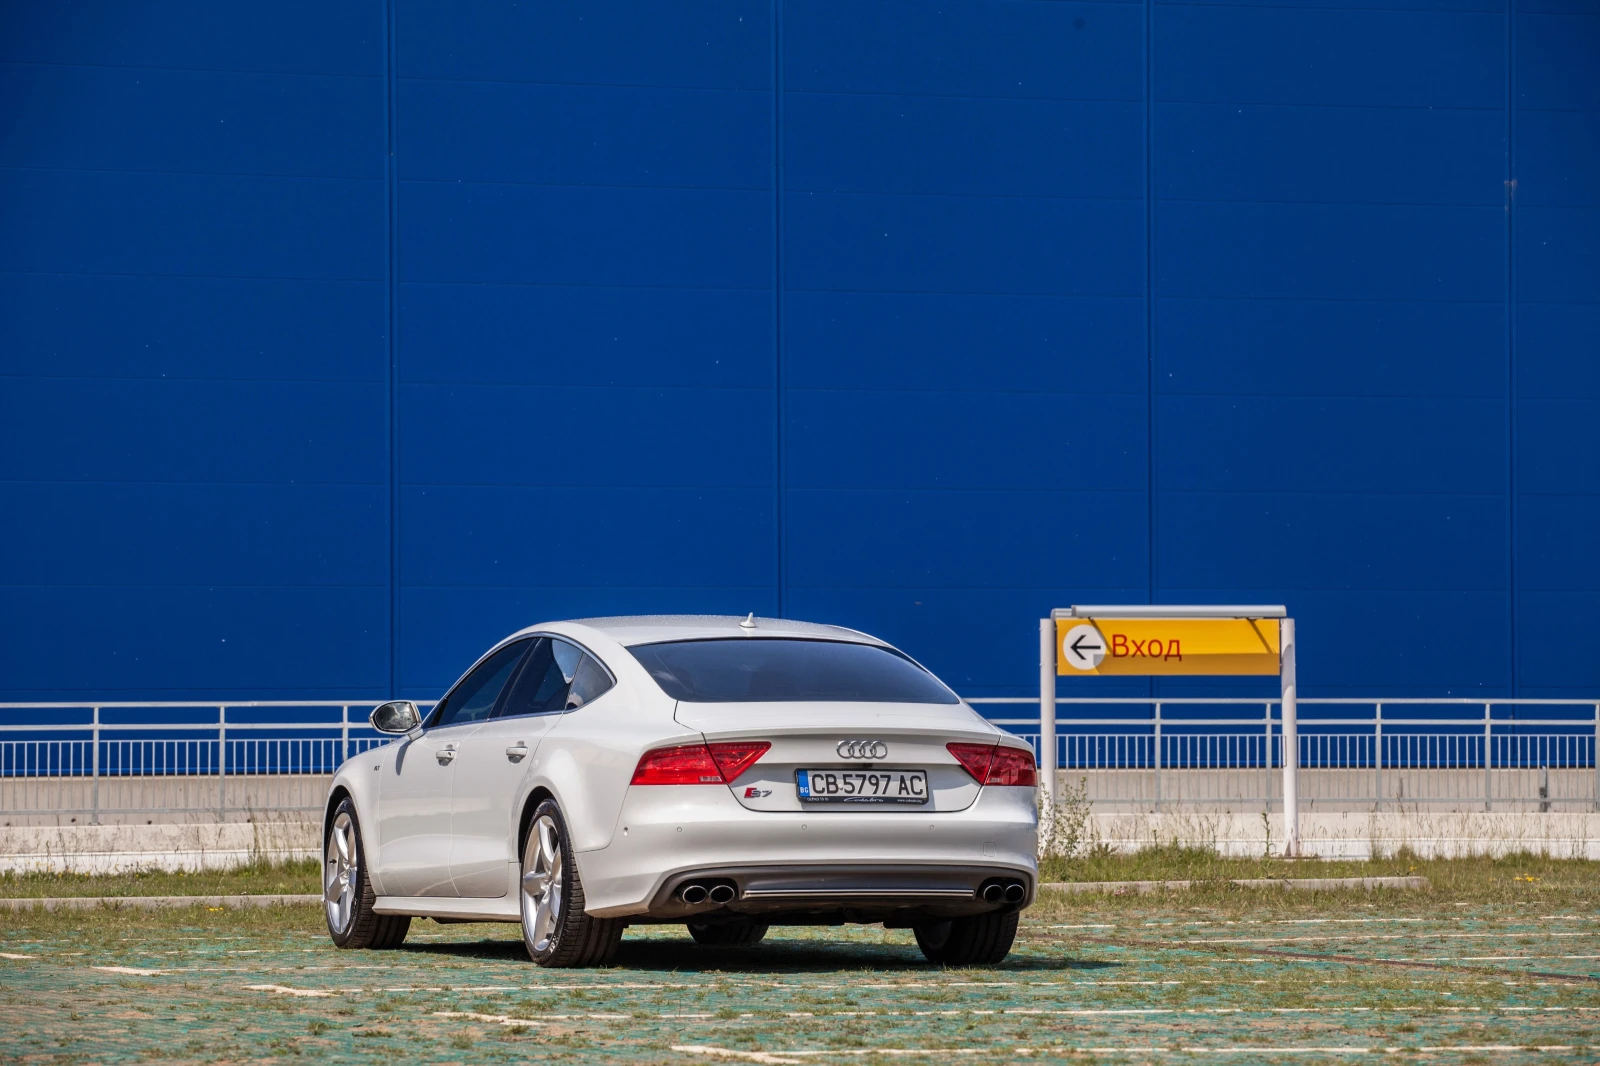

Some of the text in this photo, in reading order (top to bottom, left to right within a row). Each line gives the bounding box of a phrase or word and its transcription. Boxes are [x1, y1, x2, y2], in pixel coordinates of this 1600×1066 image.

[1112, 634, 1182, 662] Вход
[747, 788, 773, 798] S7
[812, 773, 924, 796] CB 5797 AC
